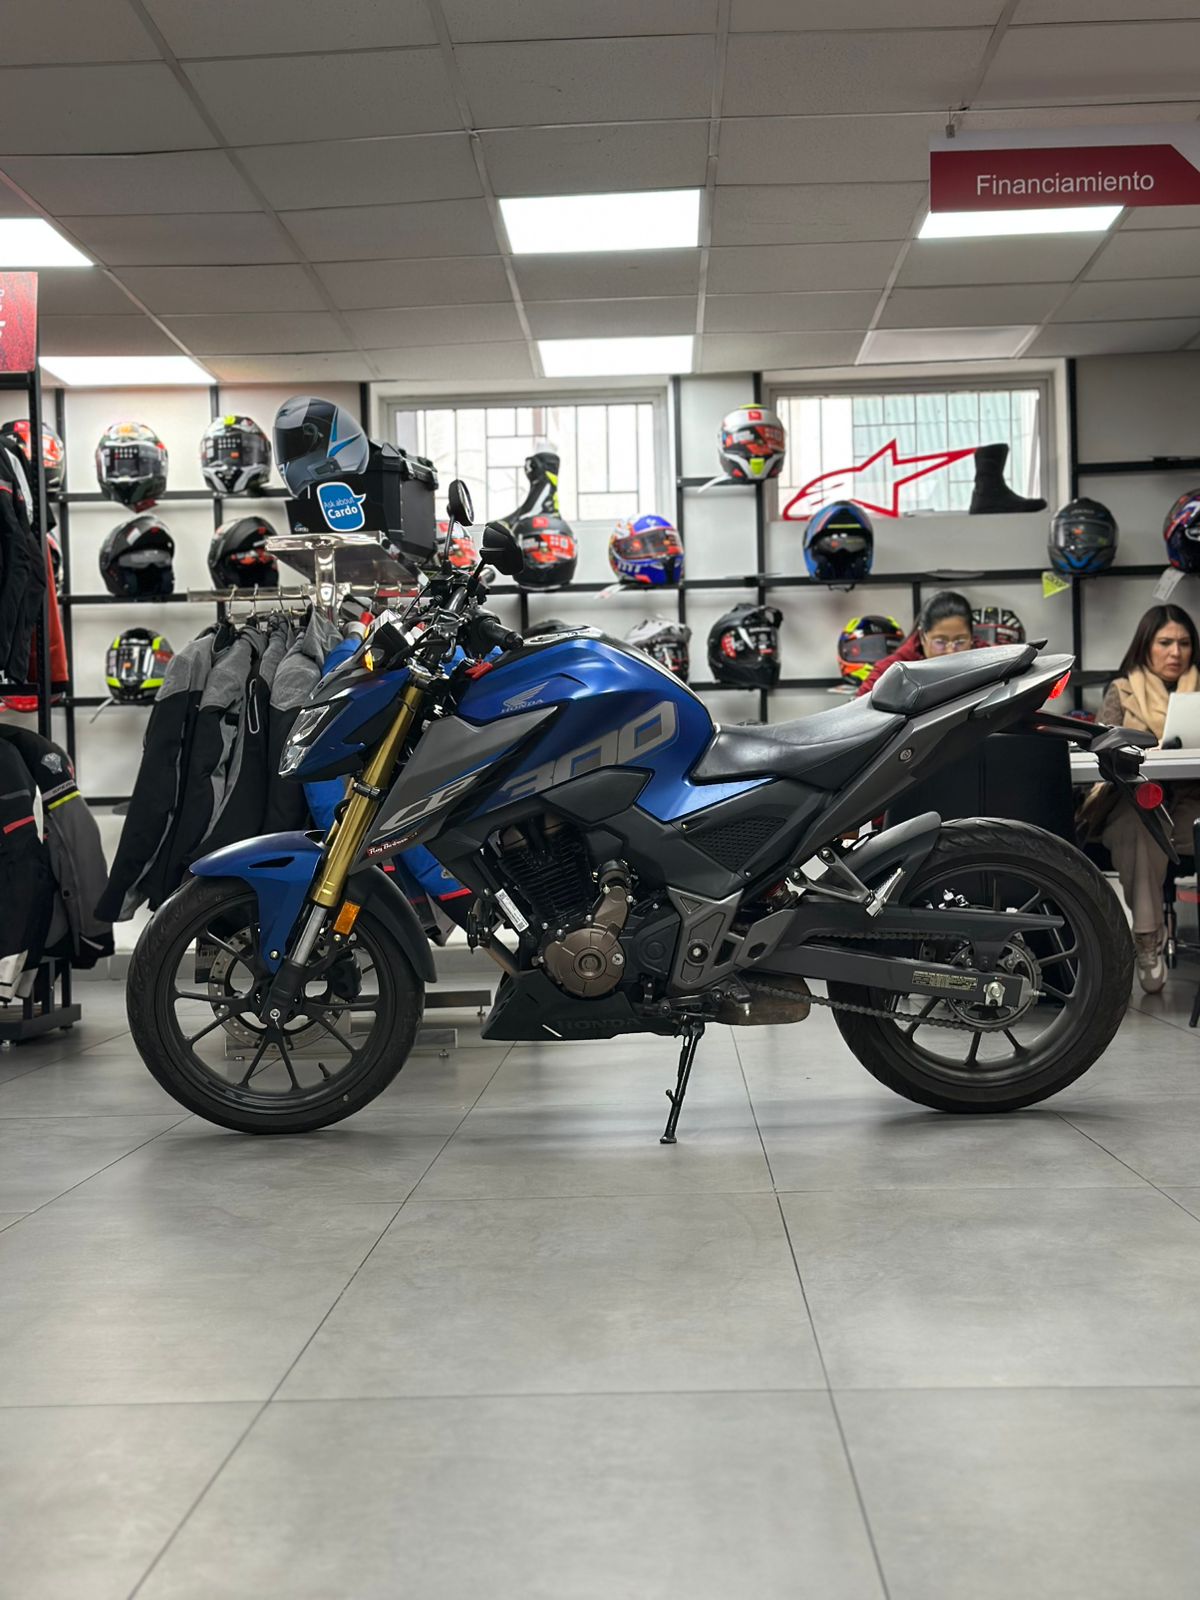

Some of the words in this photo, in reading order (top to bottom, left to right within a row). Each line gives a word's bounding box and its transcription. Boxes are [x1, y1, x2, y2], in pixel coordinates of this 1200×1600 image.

[976, 171, 1155, 195] Financiamiento
[324, 501, 336, 509] Ask
[328, 506, 358, 518] Cardo
[501, 699, 544, 713] HONDA
